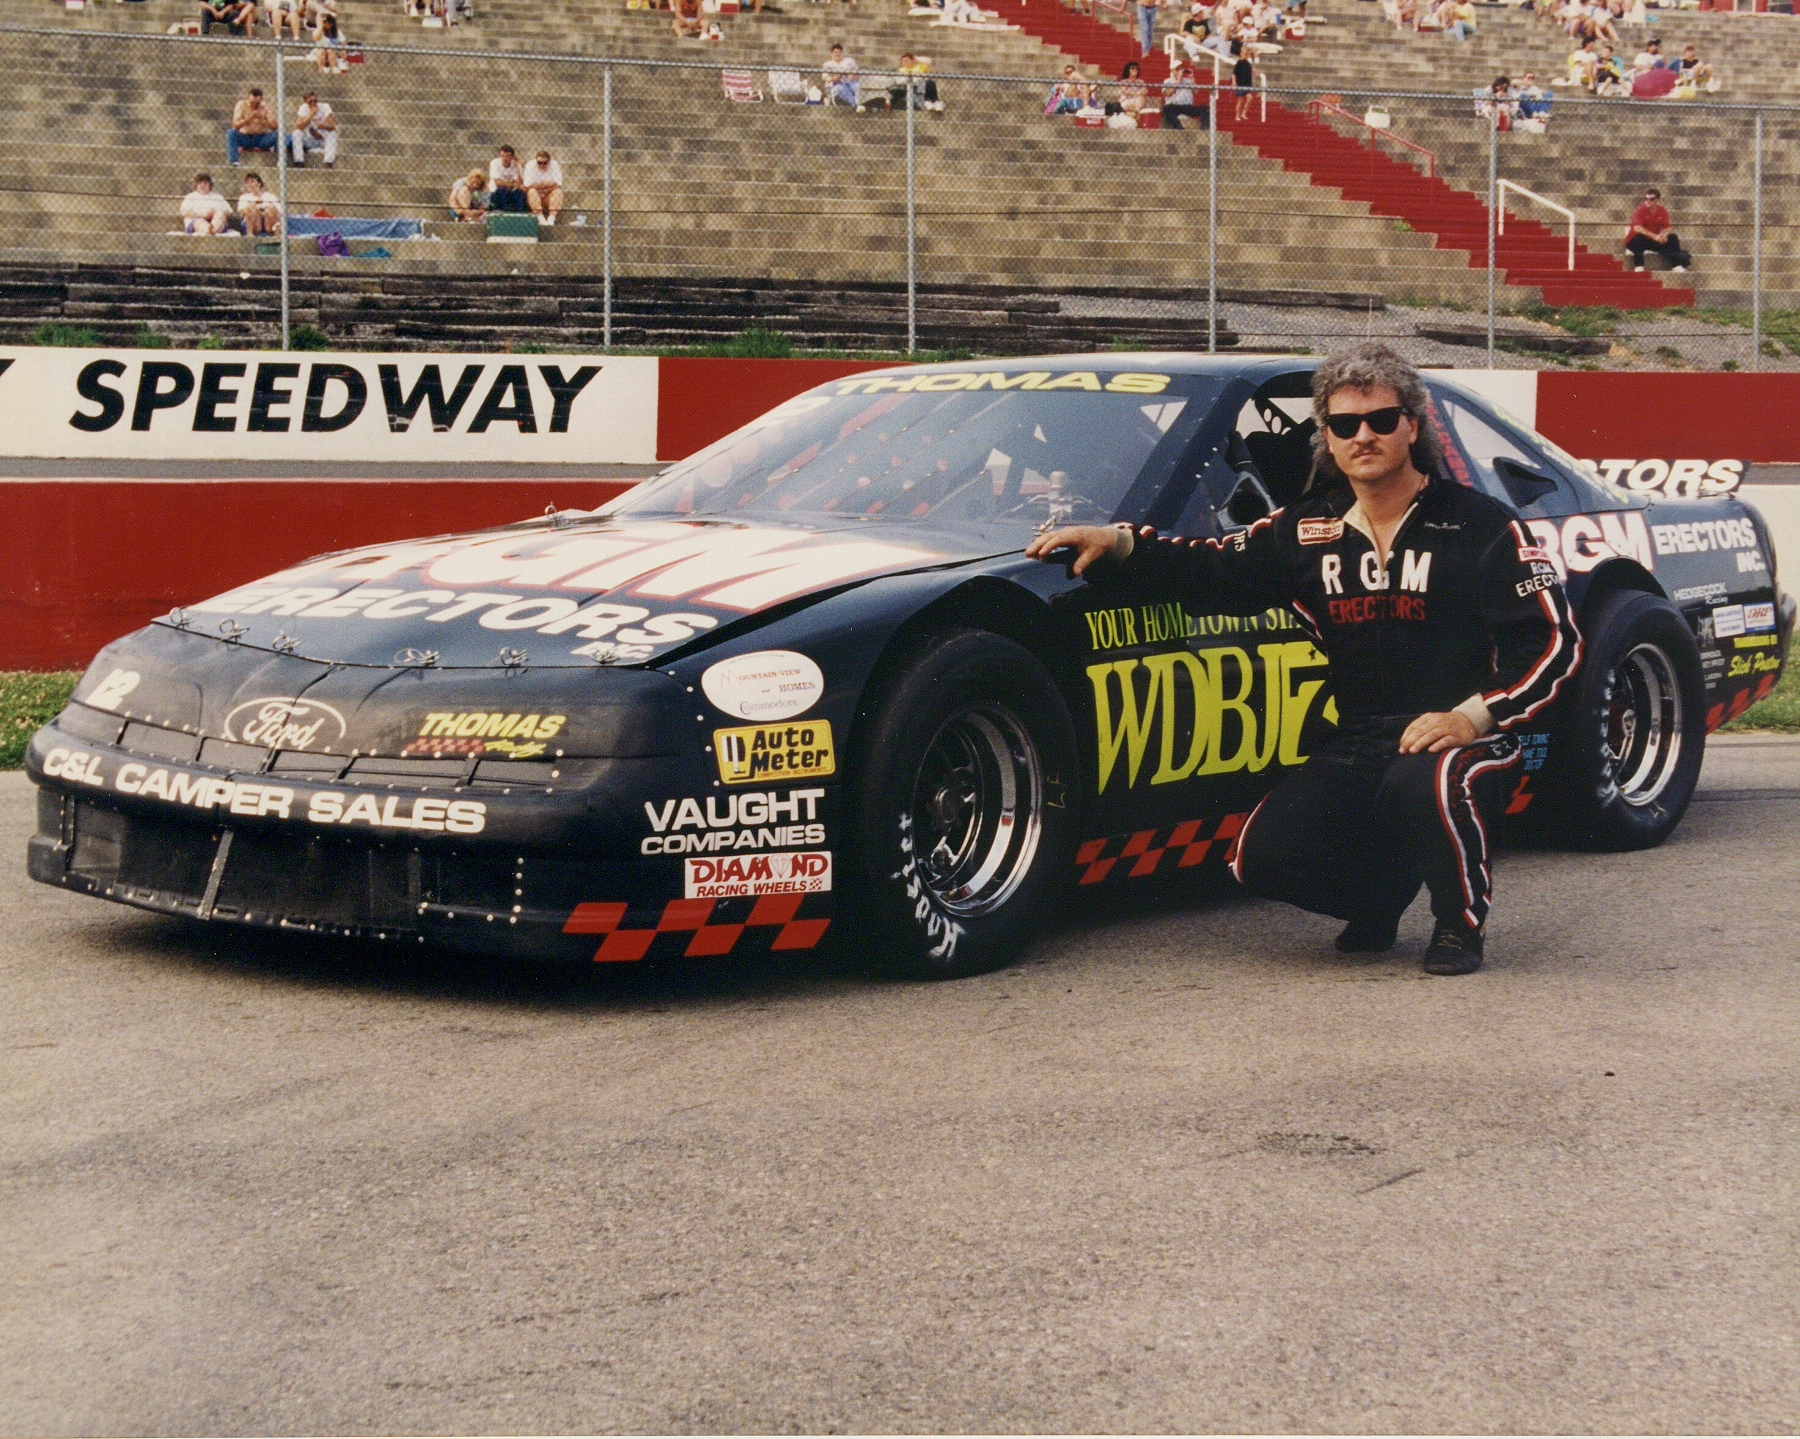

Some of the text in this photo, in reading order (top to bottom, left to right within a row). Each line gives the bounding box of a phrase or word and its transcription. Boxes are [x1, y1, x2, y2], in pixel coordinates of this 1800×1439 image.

[68, 359, 604, 434] SPEEDWAY
[836, 372, 1171, 394] THOMAS
[1578, 458, 1743, 494] TORS
[1301, 525, 1341, 537] Winston
[1652, 517, 1757, 555] ERECTORS
[1736, 551, 1766, 573] INC.
[200, 586, 719, 645] ERECTORS
[1085, 607, 1138, 650] YOUR
[779, 681, 816, 693] HOMES
[740, 700, 799, 715] Commodore
[242, 702, 325, 750] Ford
[419, 712, 566, 738] THOMAS
[752, 727, 814, 751] Auto
[750, 748, 829, 773] Meter
[43, 748, 486, 833] C&L CAMPER SALES
[644, 788, 825, 832] VAUGHT
[641, 823, 826, 855] COMPANIES
[696, 880, 807, 897] RACING WHEELS
